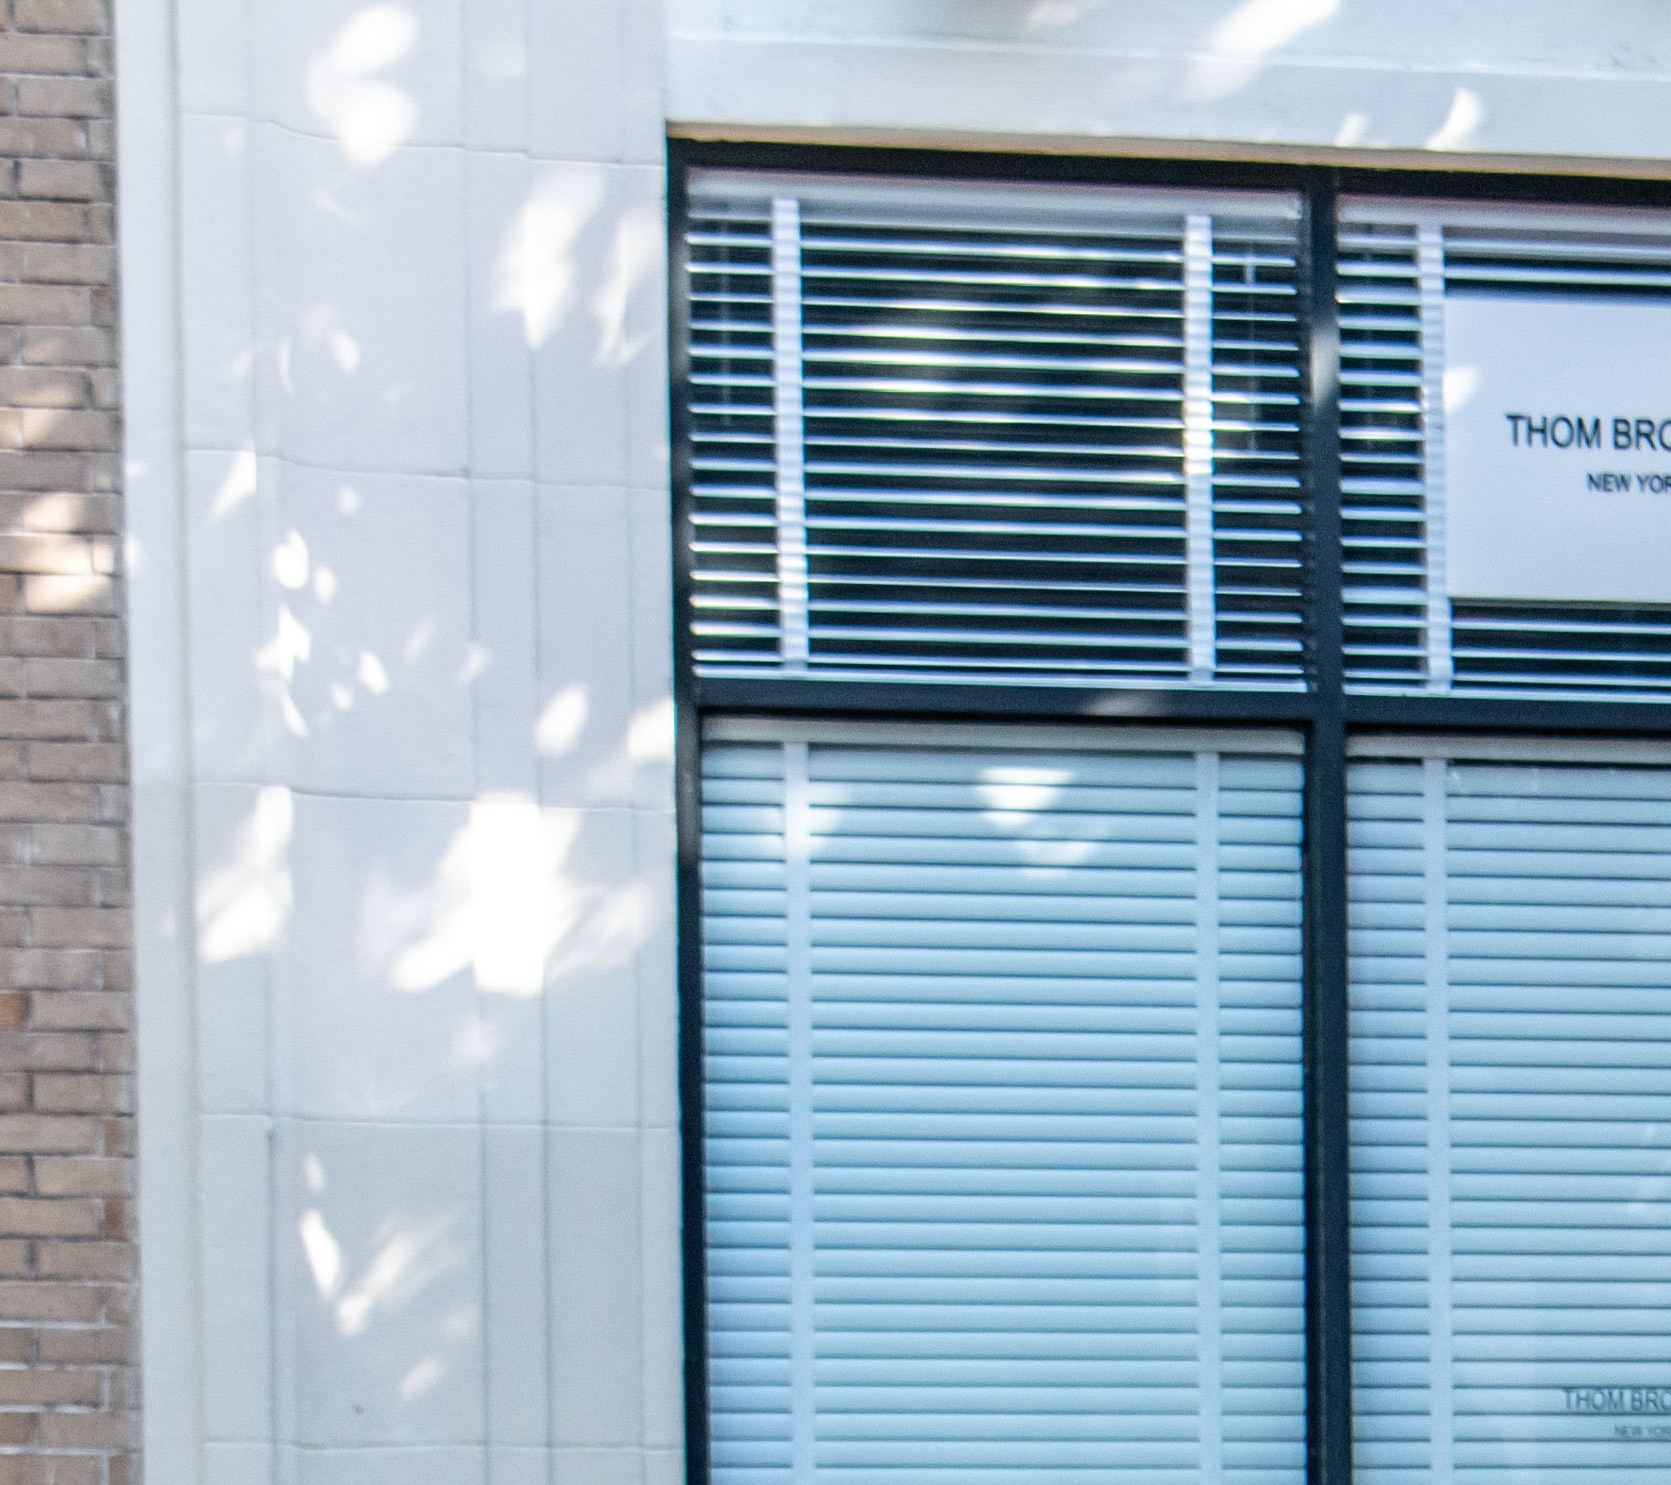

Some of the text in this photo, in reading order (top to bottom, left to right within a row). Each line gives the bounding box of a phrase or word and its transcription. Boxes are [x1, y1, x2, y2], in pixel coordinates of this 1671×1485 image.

[1507, 414, 1601, 448] THOM
[1587, 473, 1630, 493] NEW
[1562, 1386, 1625, 1412] THOM
[1614, 1424, 1642, 1438] NEW
